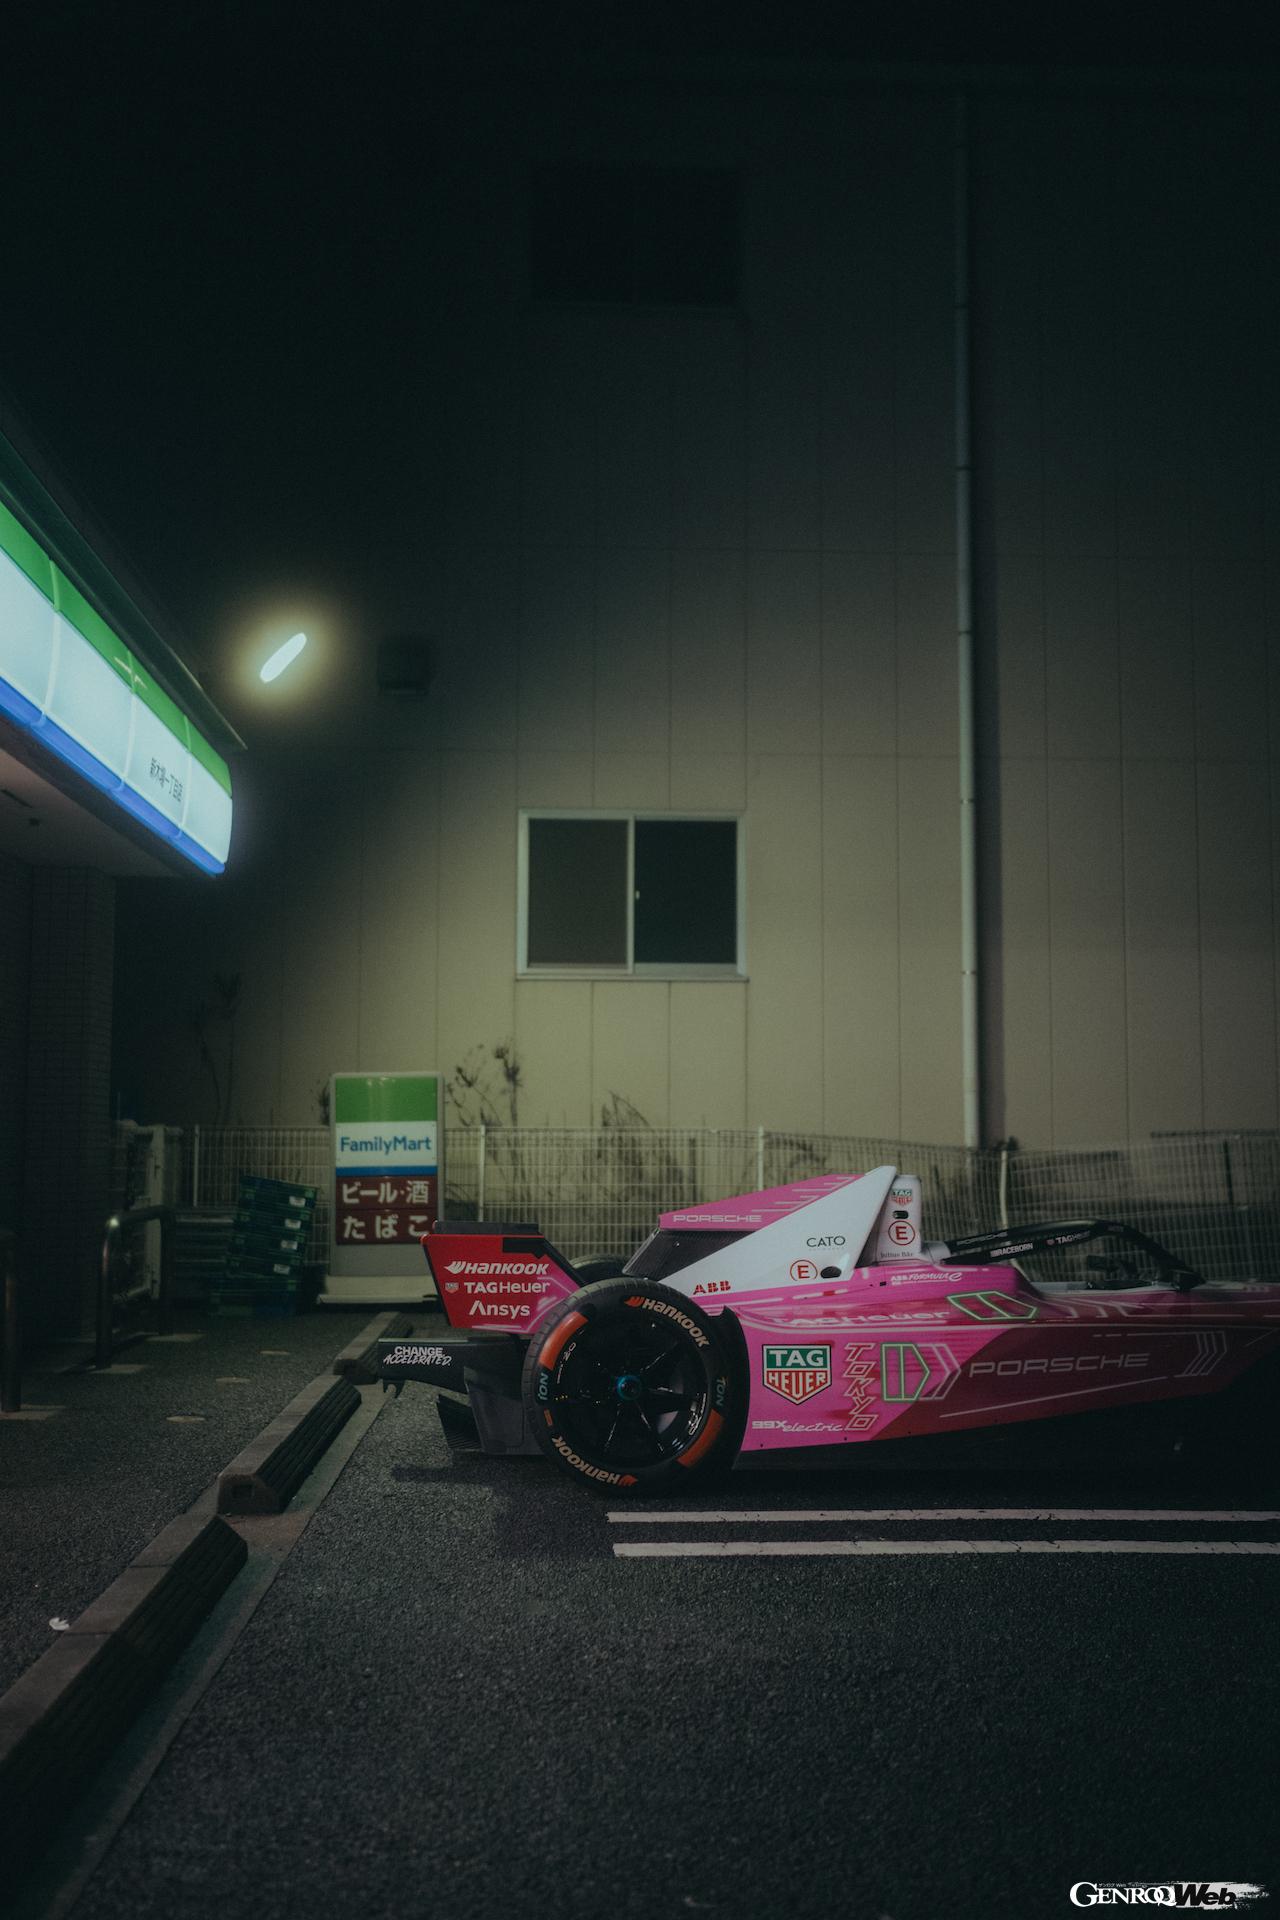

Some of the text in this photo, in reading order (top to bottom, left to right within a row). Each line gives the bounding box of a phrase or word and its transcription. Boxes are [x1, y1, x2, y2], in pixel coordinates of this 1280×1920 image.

[340, 1136, 431, 1155] FamilyMart
[341, 1180, 430, 1205] ビール・酒
[343, 1214, 431, 1240] たばこ
[673, 1214, 762, 1223] PORSCHE
[806, 1236, 846, 1247] CATO
[895, 1226, 908, 1240] E
[797, 1265, 810, 1279] E
[693, 1280, 731, 1295] ABB
[469, 1300, 530, 1320] Ansys
[767, 1349, 824, 1367] TAG
[969, 1353, 1151, 1378] PORSCHE
[768, 1371, 827, 1399] HEUER
[842, 1342, 879, 1432] TOKYO
